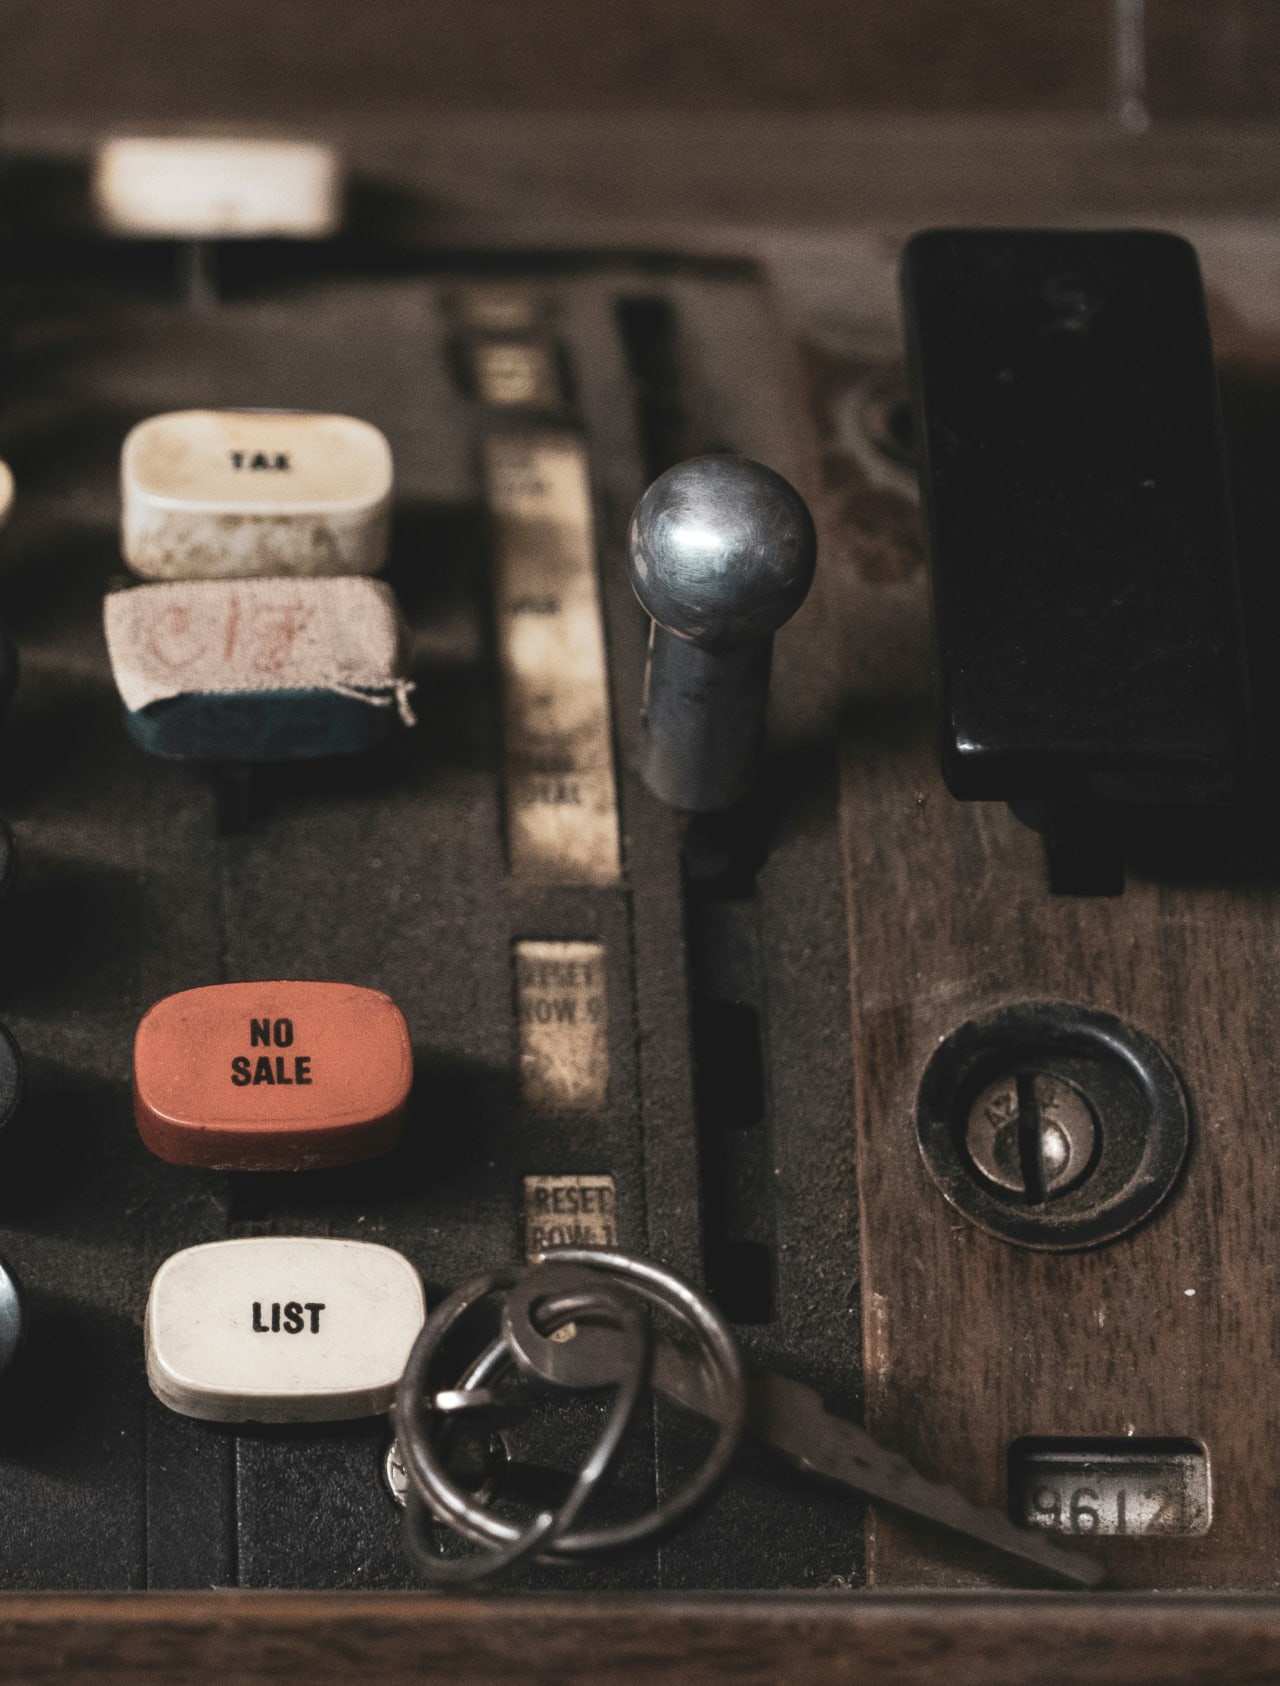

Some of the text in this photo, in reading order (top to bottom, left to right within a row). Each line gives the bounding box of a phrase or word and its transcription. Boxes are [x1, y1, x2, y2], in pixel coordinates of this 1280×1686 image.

[230, 451, 291, 473] TAX
[250, 1017, 294, 1049] NO
[231, 1055, 313, 1087] SALE
[533, 1186, 614, 1214] RESET
[252, 1301, 326, 1335] LIST
